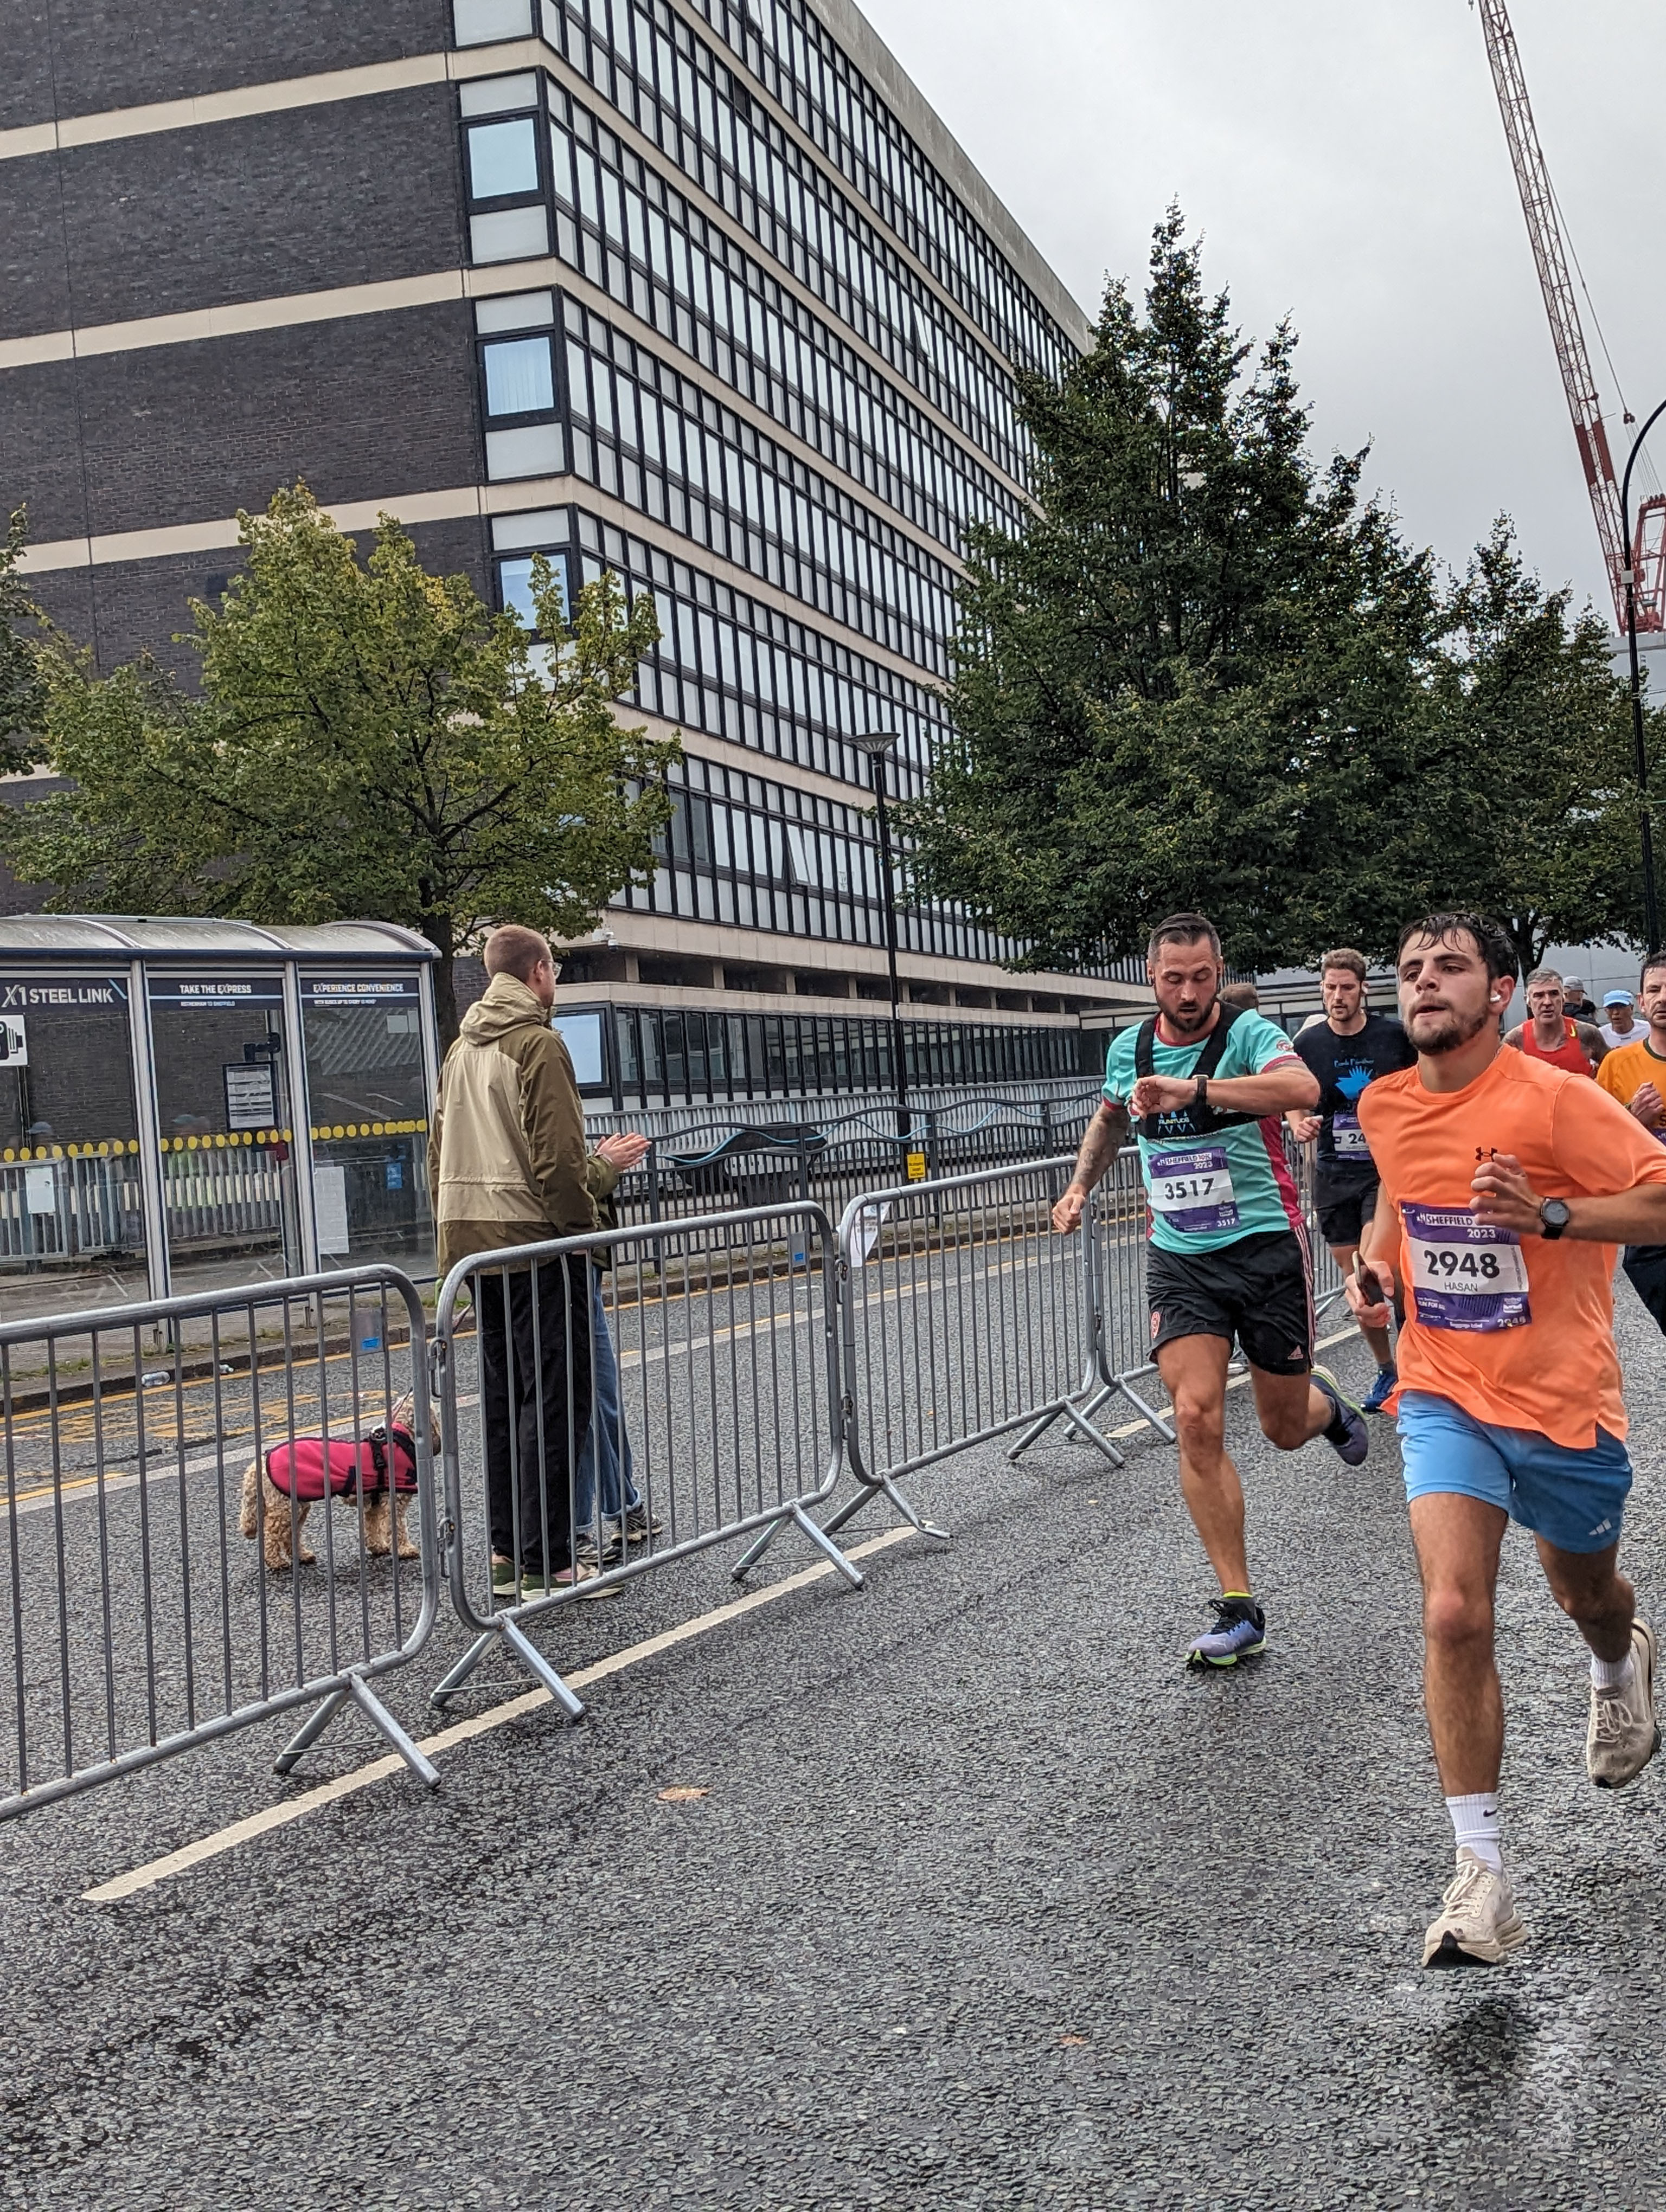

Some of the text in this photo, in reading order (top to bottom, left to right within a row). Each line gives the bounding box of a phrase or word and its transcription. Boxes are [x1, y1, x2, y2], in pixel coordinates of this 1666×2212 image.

[179, 983, 252, 994] TAKE THE EXPRESS
[313, 983, 404, 993] EXPERIENCE CONVENIENCE
[1, 984, 114, 1007] X1 STEEL LINK
[1194, 1161, 1213, 1169] 2023
[1165, 1178, 1214, 1200] 3517
[1217, 1218, 1235, 1227] 3517
[1427, 1216, 1472, 1226] SHEFFIELD
[1467, 1229, 1496, 1238] 2023
[1424, 1250, 1500, 1278] 2948
[1444, 1282, 1478, 1292] HASAN
